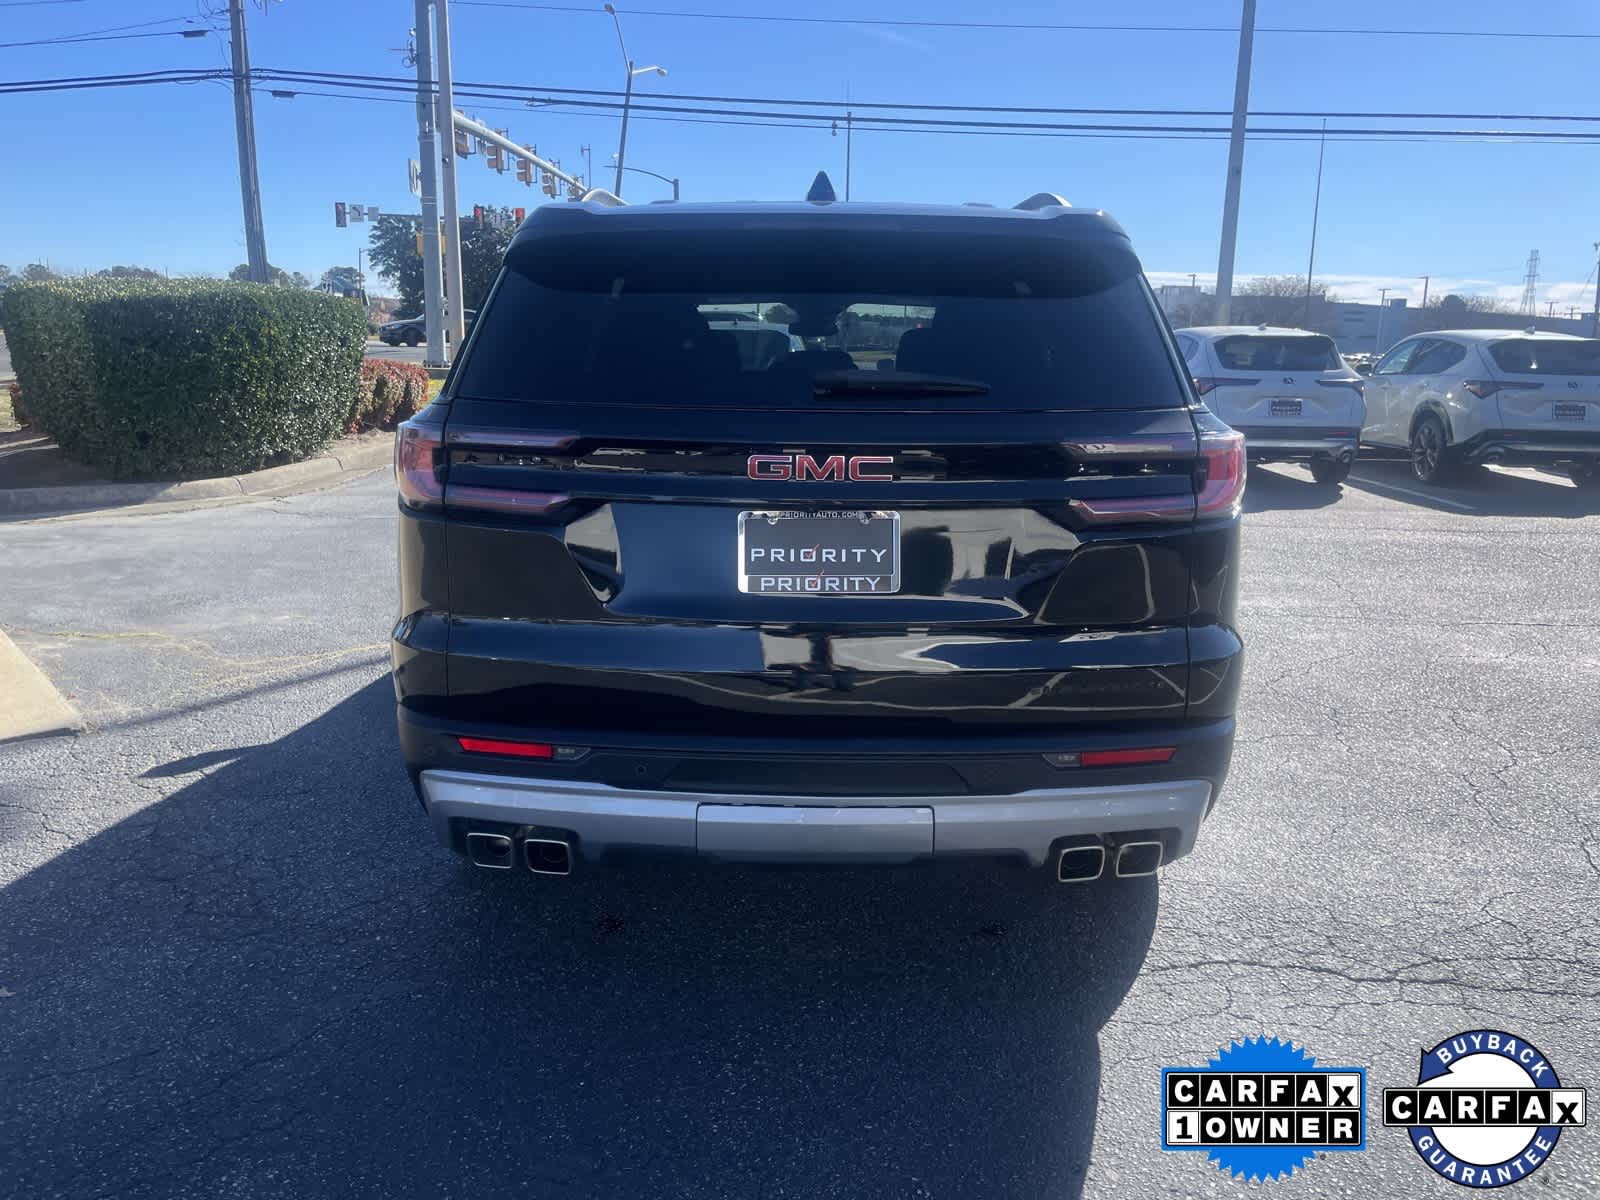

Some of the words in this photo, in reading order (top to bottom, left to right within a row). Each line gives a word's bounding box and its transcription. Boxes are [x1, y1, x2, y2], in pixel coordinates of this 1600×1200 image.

[747, 454, 894, 482] GMC
[751, 548, 887, 563] PRIORITY
[760, 576, 881, 592] PRIORITY
